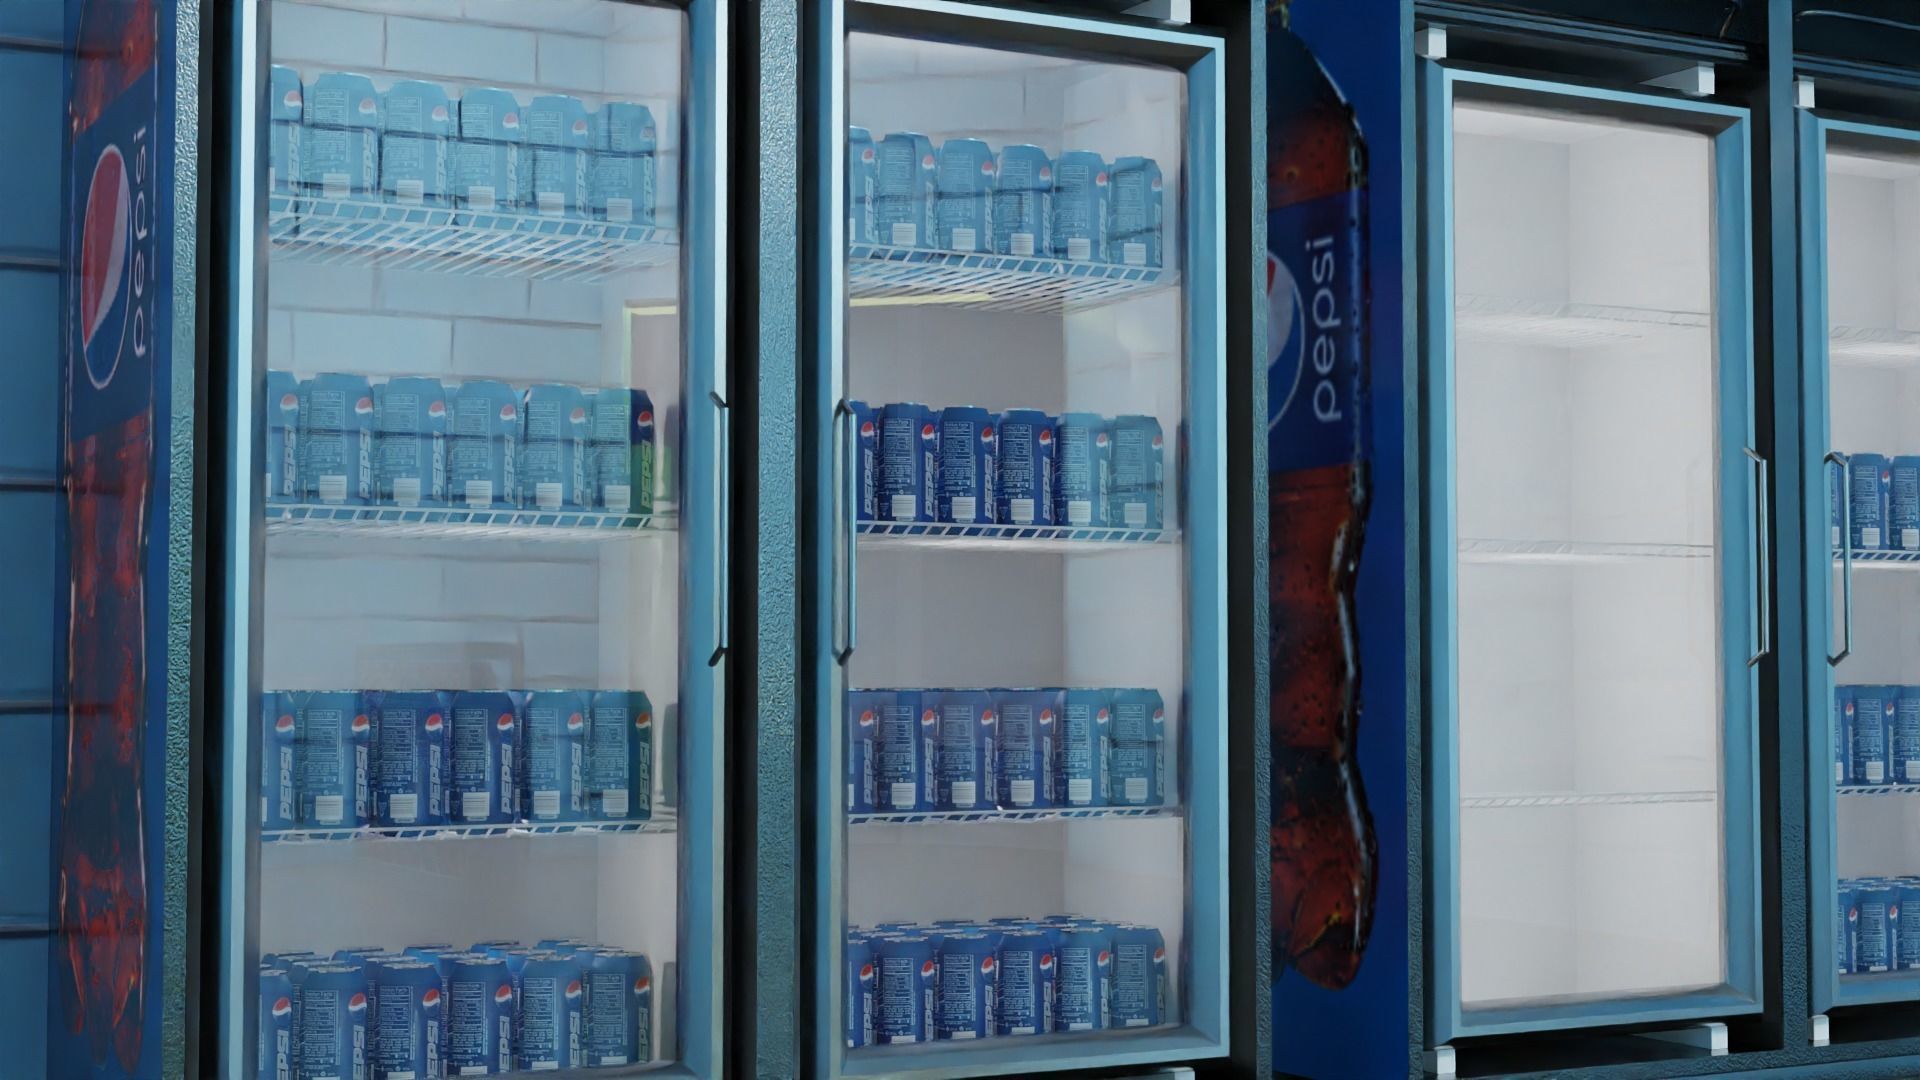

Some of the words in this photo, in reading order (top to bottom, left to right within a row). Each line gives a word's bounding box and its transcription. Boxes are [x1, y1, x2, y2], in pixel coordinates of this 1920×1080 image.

[133, 126, 147, 356] pepsi
[1305, 236, 1342, 422] pepsi
[283, 424, 296, 496] PEPSI
[359, 427, 371, 499] PEPSI
[432, 430, 443, 501] PEPSI
[504, 433, 515, 504] PEPSI
[573, 437, 584, 505] PEPSI
[641, 439, 650, 508] PEPSI
[865, 449, 873, 515] PEPSI
[925, 452, 933, 517] PEPSI
[280, 746, 292, 820] PEPSI
[356, 745, 368, 817] PEPSI
[429, 744, 441, 816] PEPSI
[501, 744, 512, 814] PEPSI
[571, 742, 582, 812] PEPSI
[640, 742, 649, 810] PEPSI
[864, 738, 872, 804] PEPSI
[925, 738, 933, 803] PEPSI
[500, 1016, 510, 1072] EPSI
[570, 1012, 580, 1068] EPSI
[638, 1008, 648, 1063] EPSI
[864, 993, 872, 1046] EPSI
[925, 989, 933, 1042] EPSI
[985, 985, 993, 1037] EPSI
[277, 1030, 289, 1080] EPSI
[353, 1025, 364, 1080] EPSI
[427, 1020, 438, 1080] EPSI
